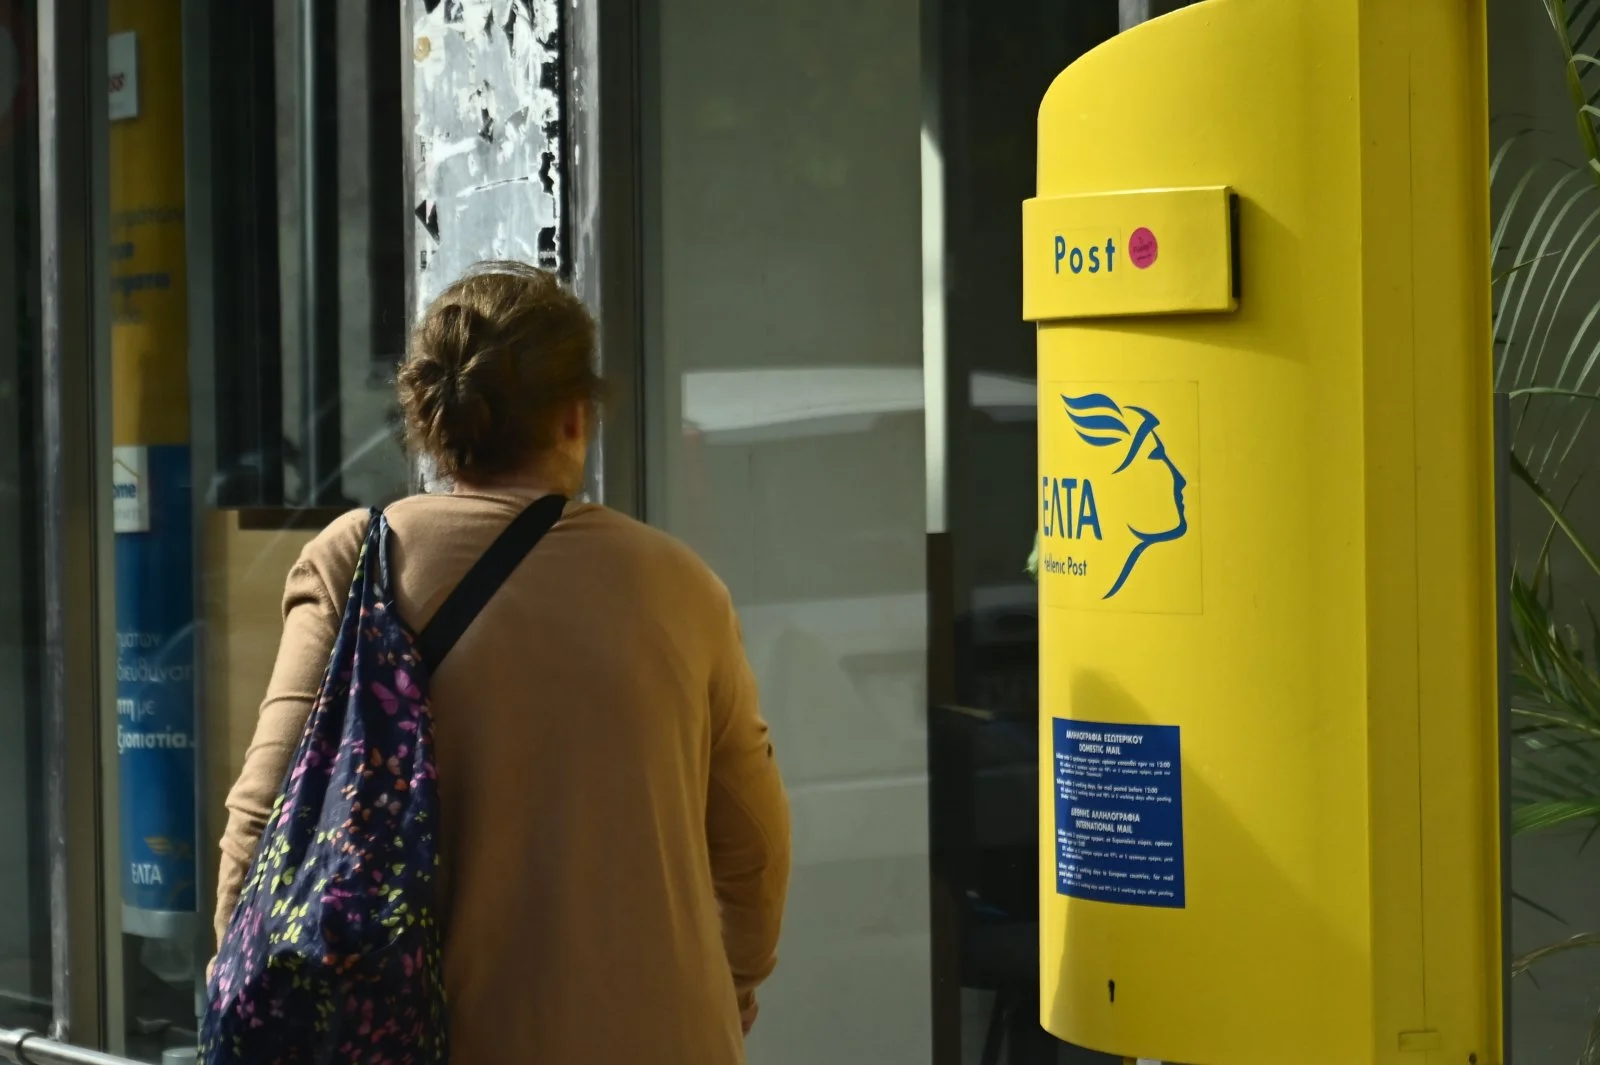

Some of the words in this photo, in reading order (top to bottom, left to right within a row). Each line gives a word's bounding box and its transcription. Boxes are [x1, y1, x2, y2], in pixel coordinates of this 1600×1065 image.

[1055, 235, 1115, 274] Post
[1043, 476, 1102, 541] ΕΛΤΑ
[1067, 556, 1087, 577] Post
[1104, 734, 1143, 745] ΕΣΩΤΕΡΙΚΟΥ
[1079, 743, 1104, 754] DOMESTIC
[1106, 746, 1121, 755] MAIL
[1091, 810, 1140, 823] ΑΛΛΗΛΟΓΡΑΦΙΑ
[1075, 819, 1115, 833] INTERNATIONAL
[1116, 824, 1133, 835] MAIL
[131, 862, 163, 885] ΕΛΤΑ
